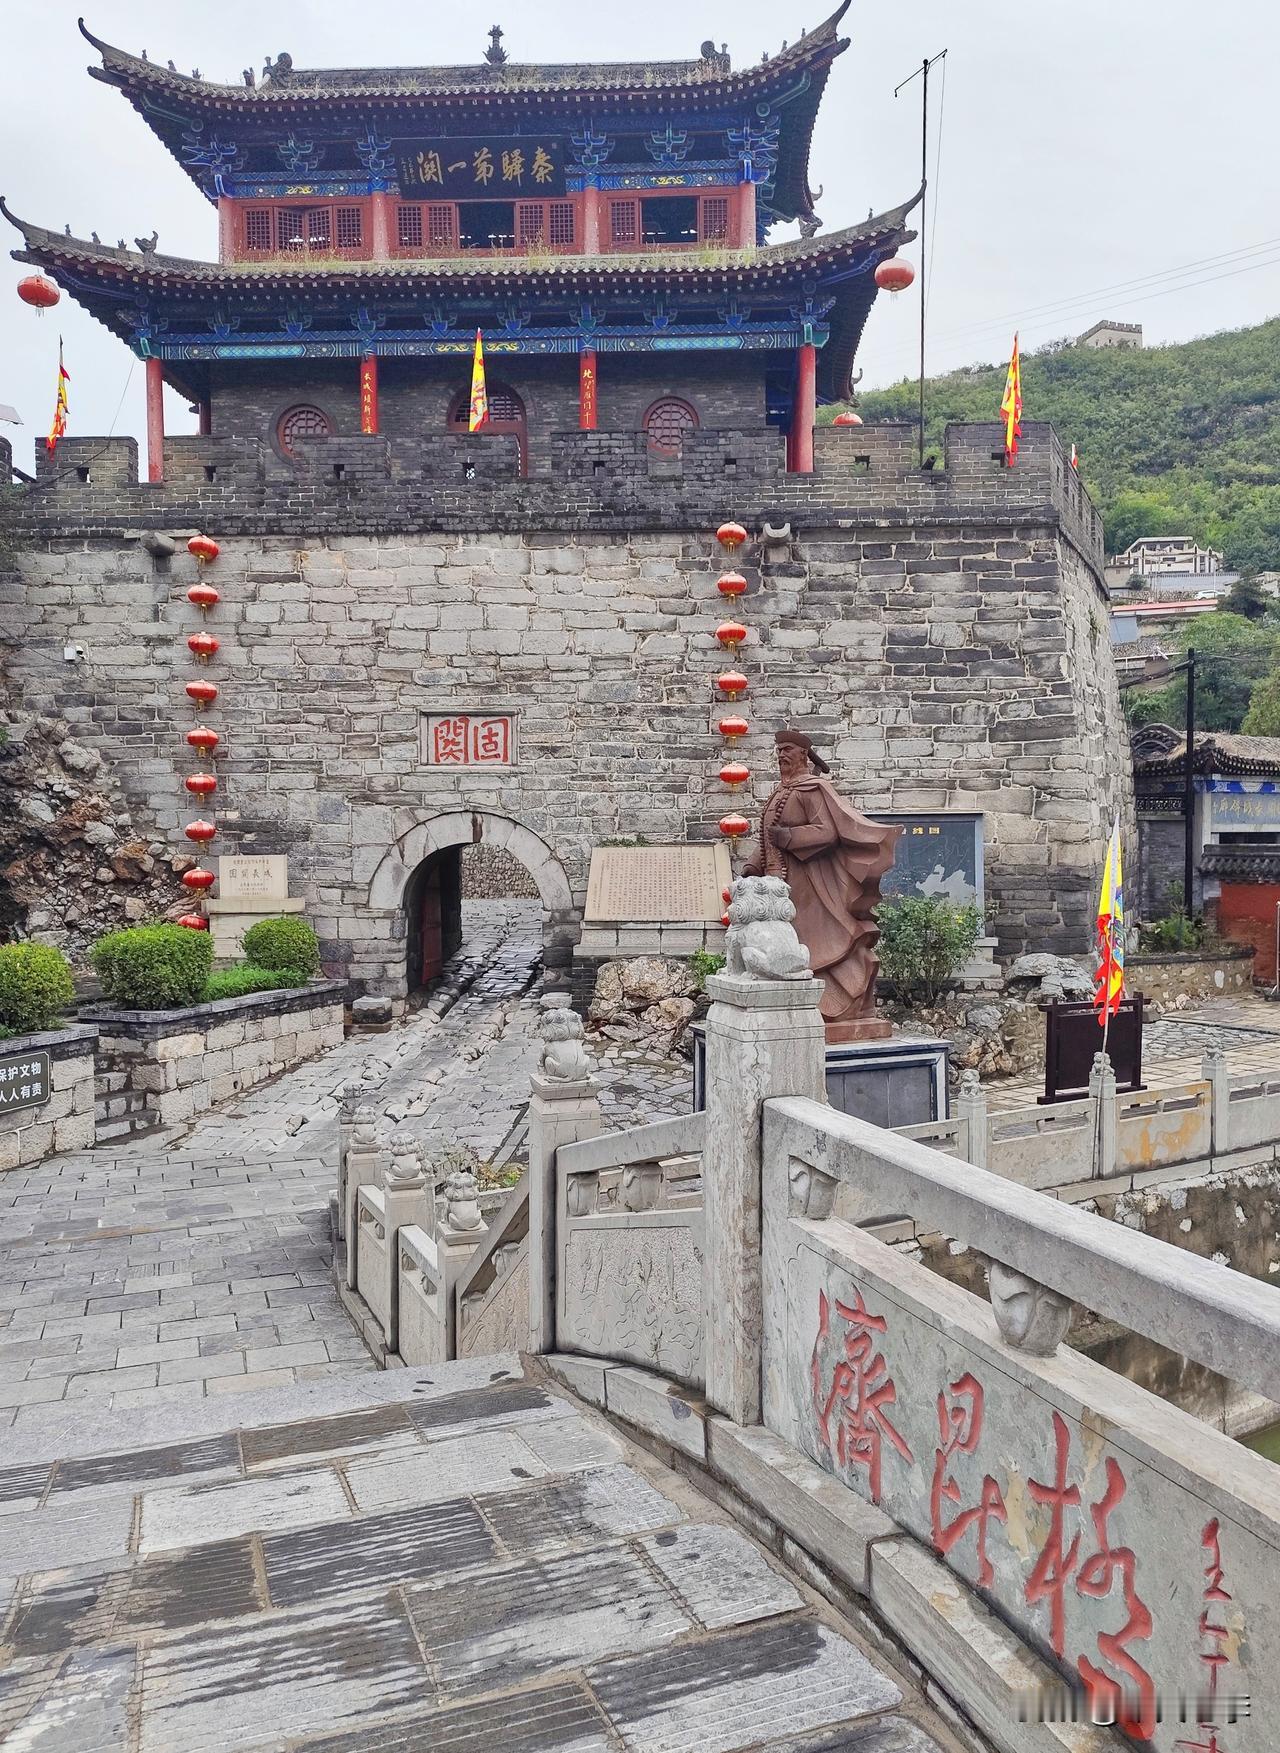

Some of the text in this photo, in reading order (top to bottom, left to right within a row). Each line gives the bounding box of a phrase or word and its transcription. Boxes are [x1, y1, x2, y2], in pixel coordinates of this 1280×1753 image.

[0, 1061, 42, 1083] 保护文物
[0, 1082, 42, 1103] 人人有责
